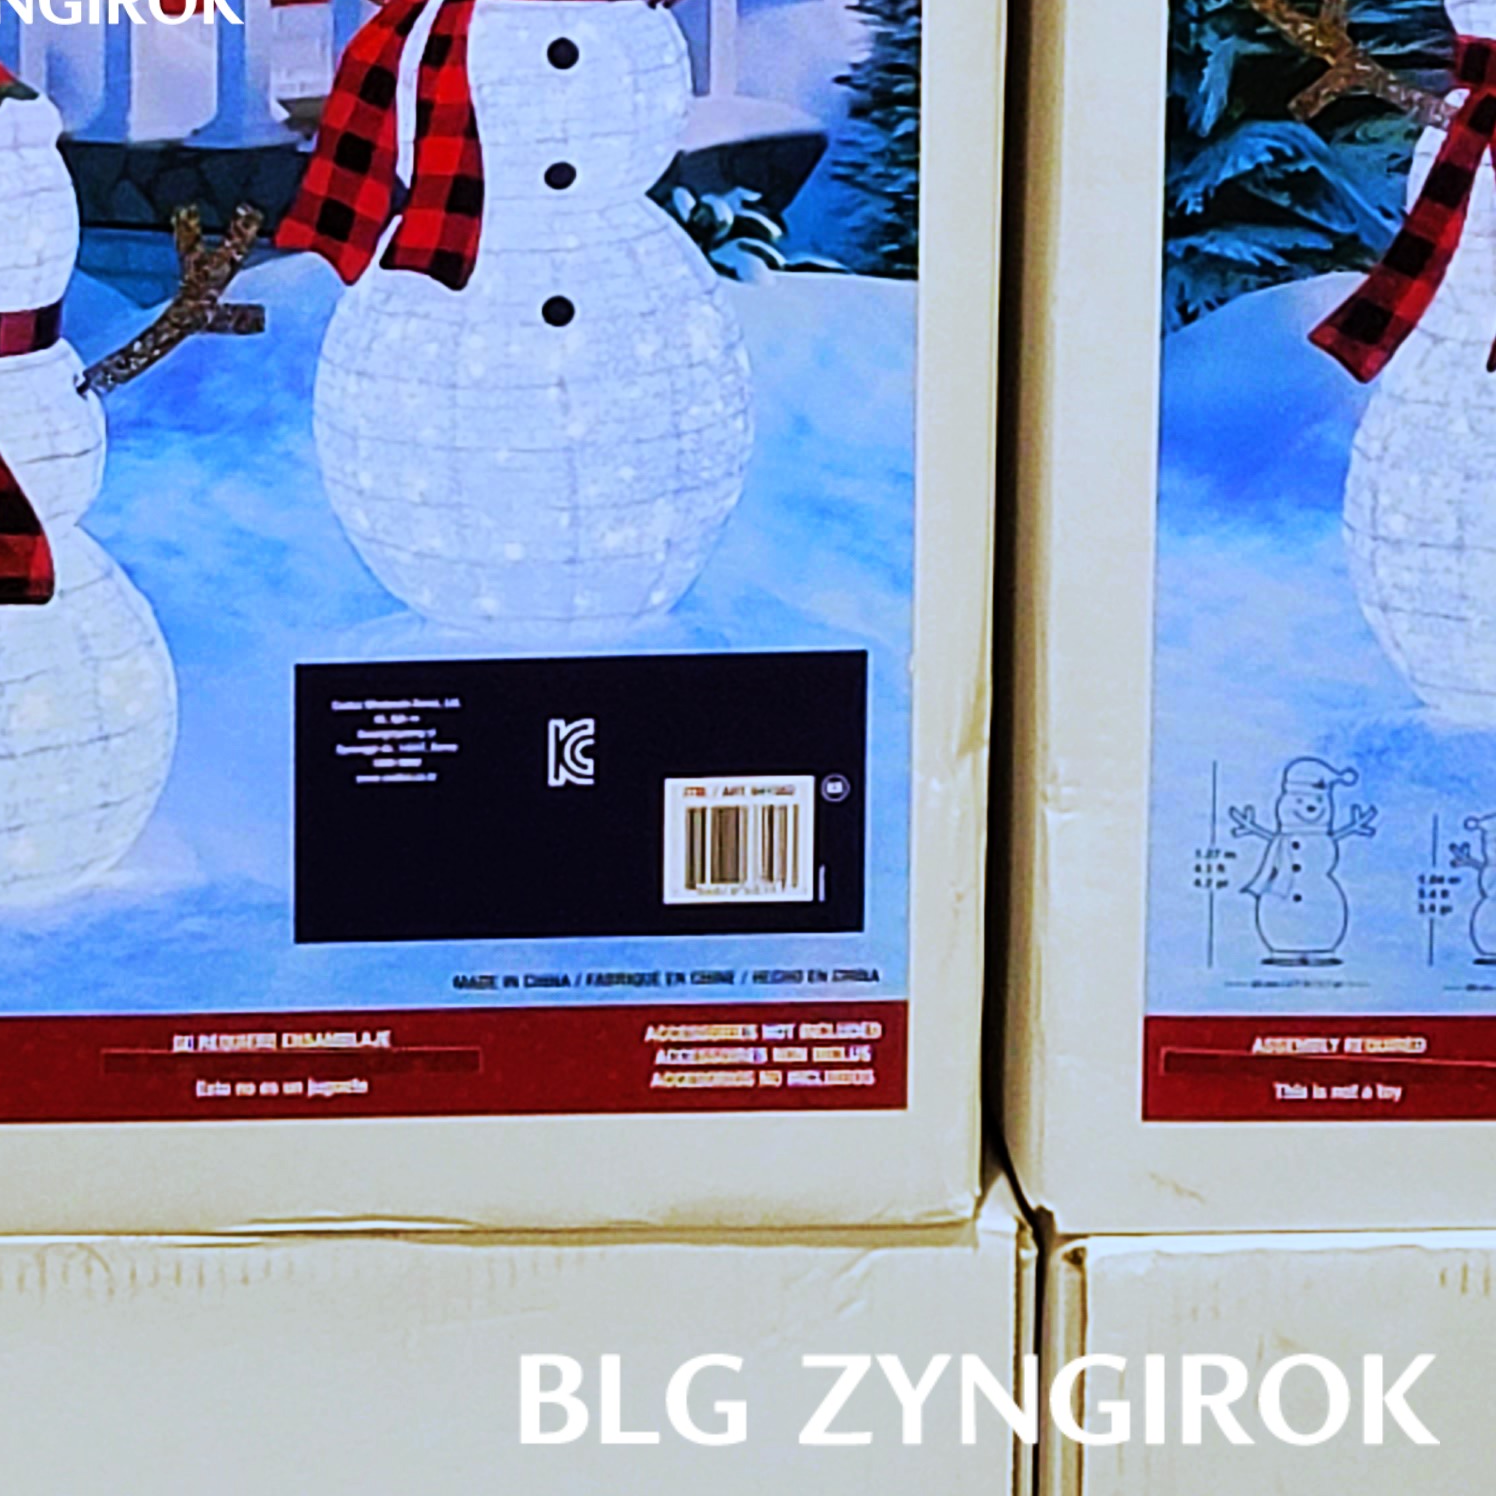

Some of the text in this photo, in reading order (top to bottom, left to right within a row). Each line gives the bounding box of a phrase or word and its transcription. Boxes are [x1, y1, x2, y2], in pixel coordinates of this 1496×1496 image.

[1274, 1082, 1402, 1102] This is not a toy
